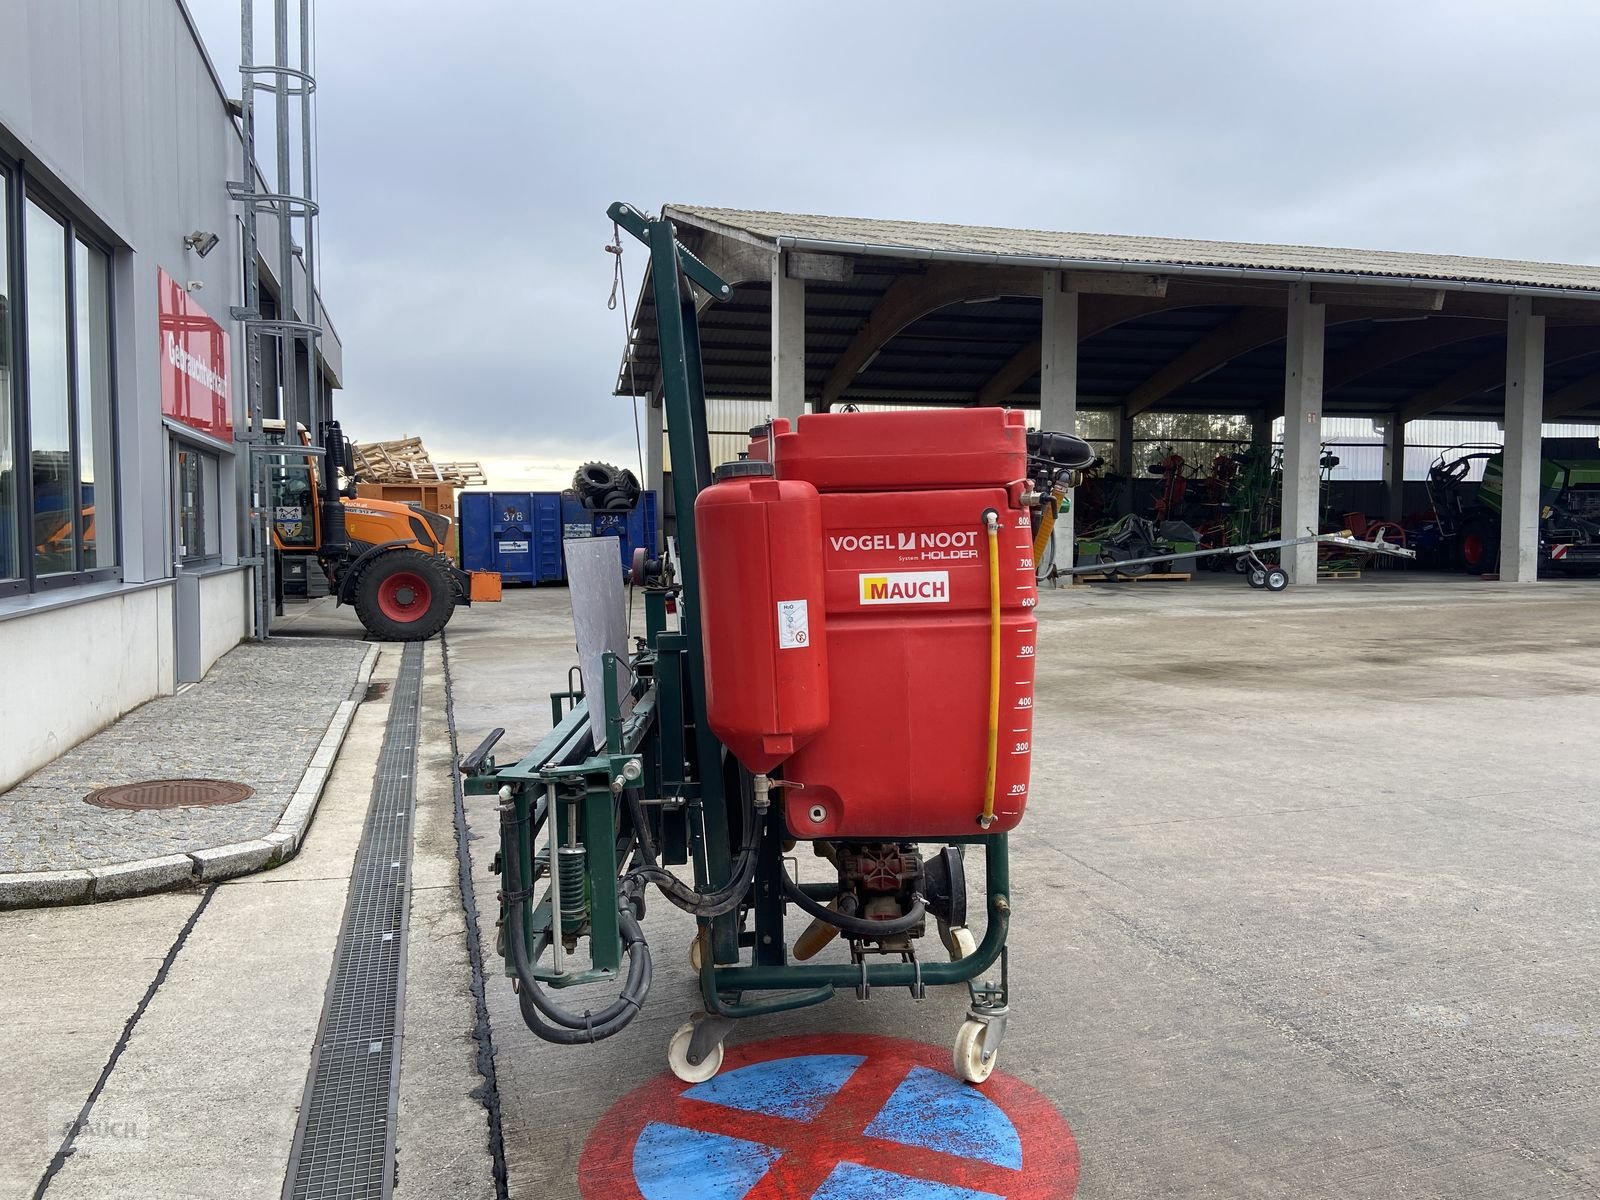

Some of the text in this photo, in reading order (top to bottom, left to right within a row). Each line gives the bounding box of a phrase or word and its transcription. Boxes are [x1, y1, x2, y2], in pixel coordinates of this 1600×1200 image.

[600, 515, 619, 525] 224
[1018, 516, 1030, 525] 800
[830, 531, 978, 551] VOGEL NOOT
[921, 550, 978, 560] HOLDER
[1020, 559, 1032, 567] 700
[870, 581, 945, 600] MAUCH
[1022, 598, 1035, 606] 600
[1021, 645, 1033, 655] 500
[1018, 697, 1031, 706] 400
[1015, 742, 1029, 751] 300
[1012, 784, 1025, 793] 200
